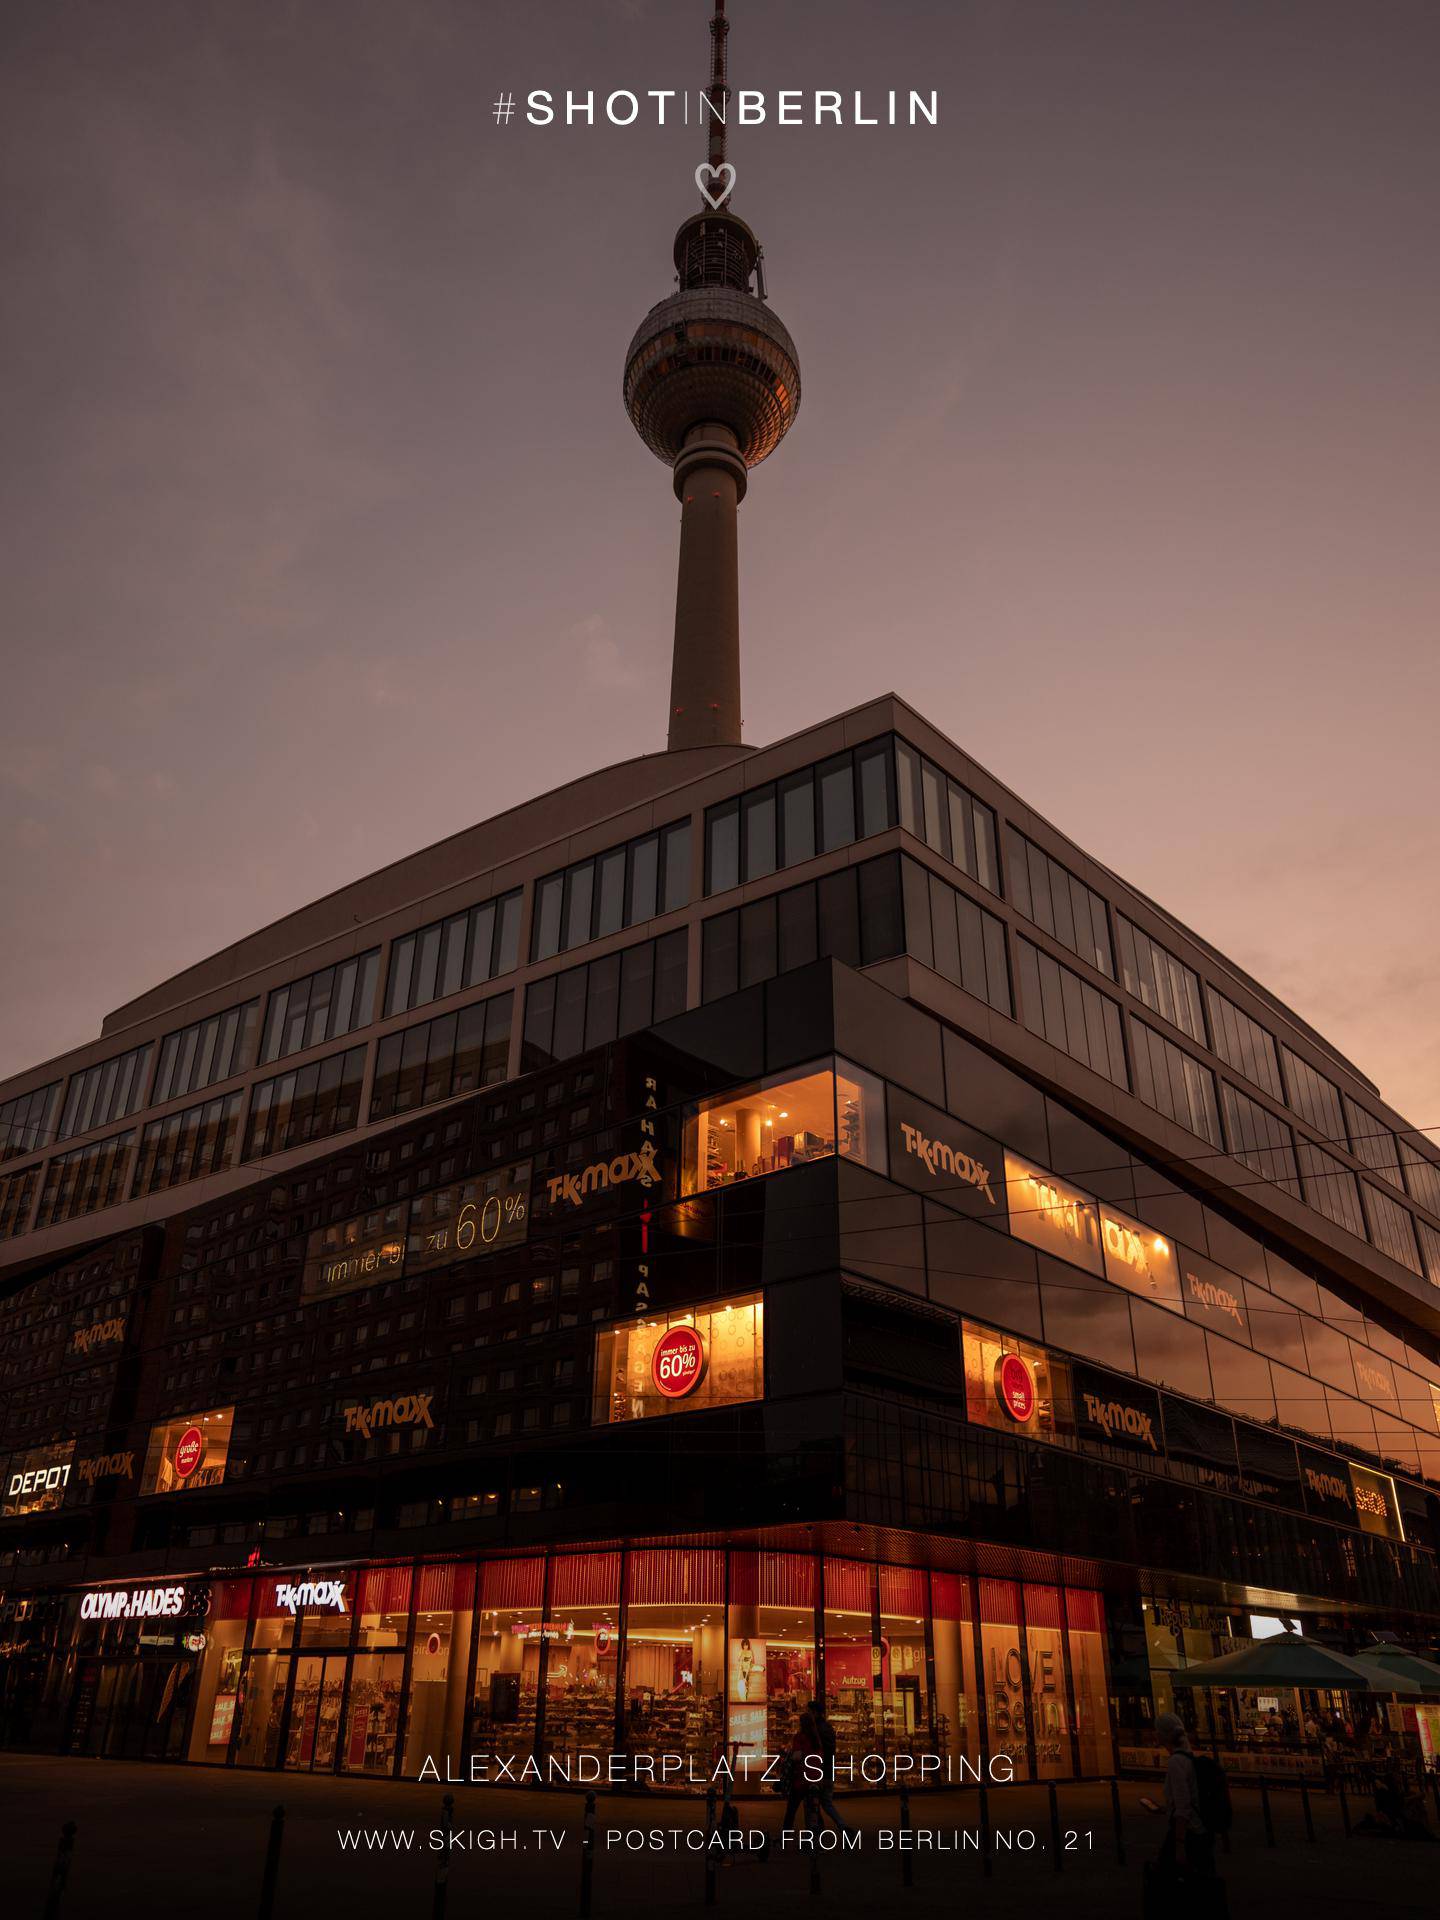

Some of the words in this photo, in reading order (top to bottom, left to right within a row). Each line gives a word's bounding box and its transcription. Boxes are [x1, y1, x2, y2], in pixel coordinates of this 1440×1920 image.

[425, 1231, 448, 1251] zu
[456, 1192, 526, 1250] 60%
[660, 1347, 678, 1357] immer
[679, 1344, 688, 1353] bis
[688, 1344, 696, 1352] zu
[660, 1352, 696, 1379] 60%
[8, 1464, 72, 1497] DEPOT
